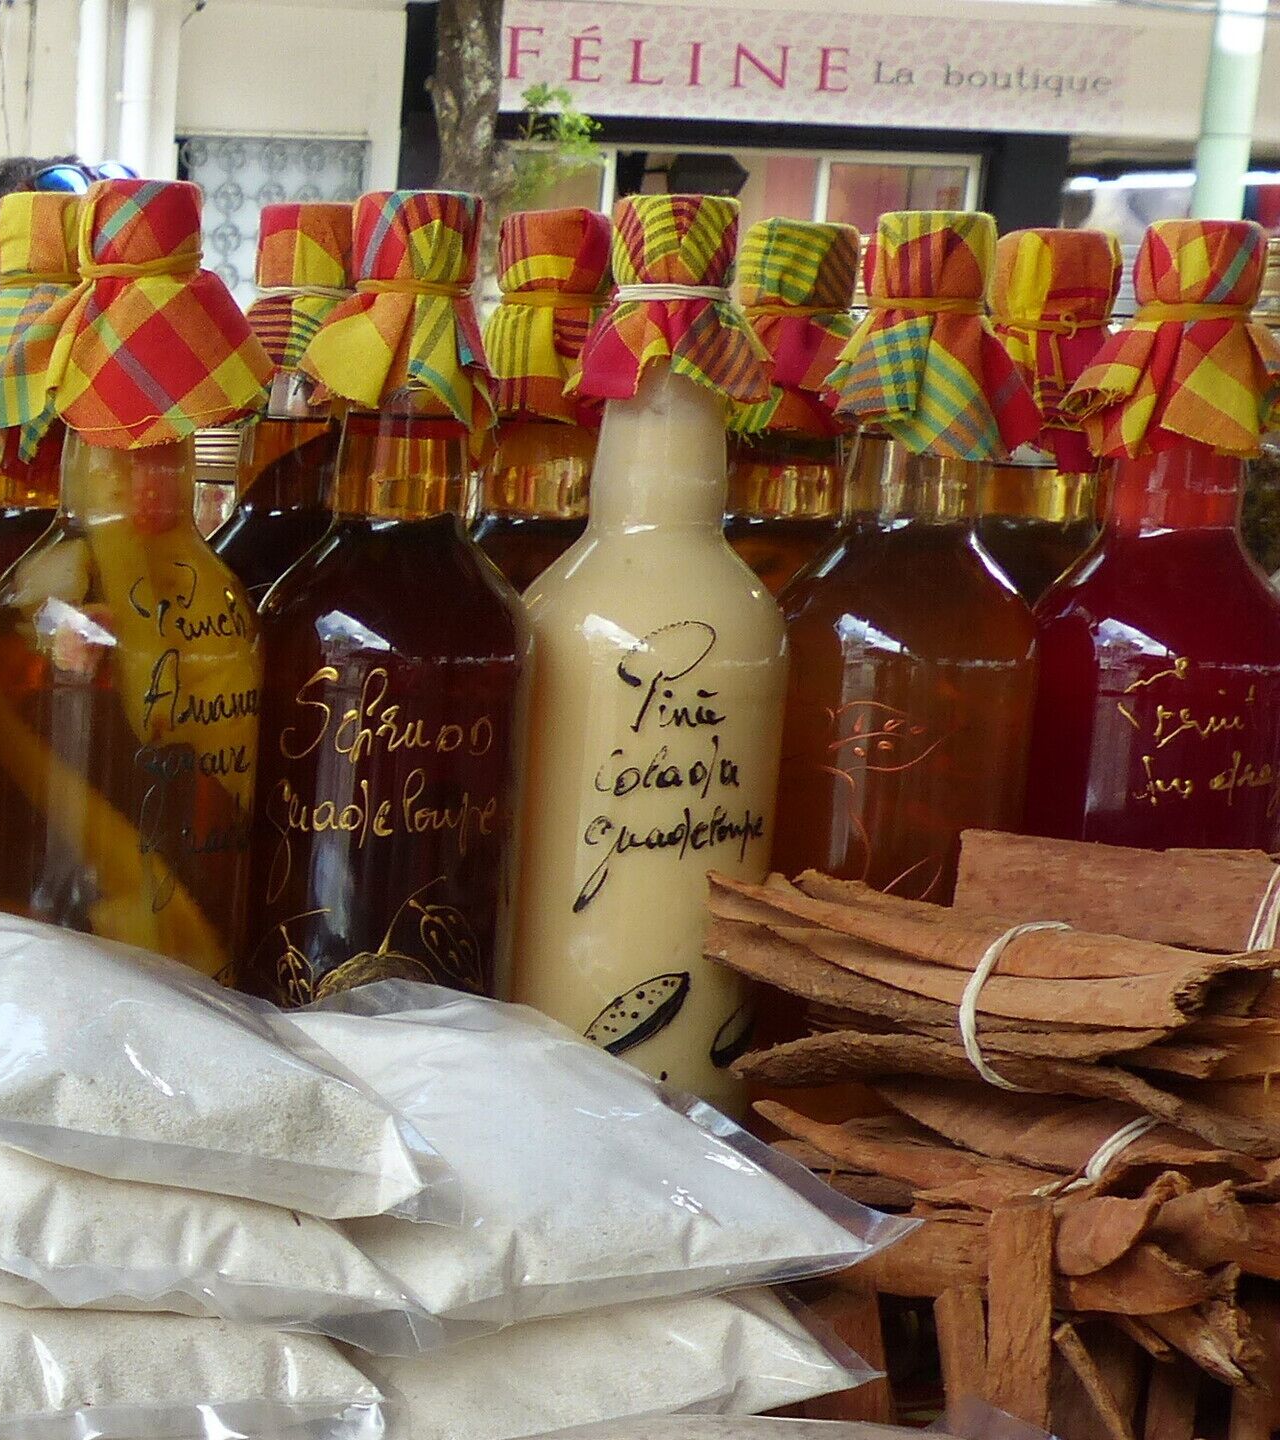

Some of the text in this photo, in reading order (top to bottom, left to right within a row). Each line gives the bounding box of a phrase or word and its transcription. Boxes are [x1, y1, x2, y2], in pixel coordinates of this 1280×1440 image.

[504, 25, 1114, 97] FÉLINE La boutique
